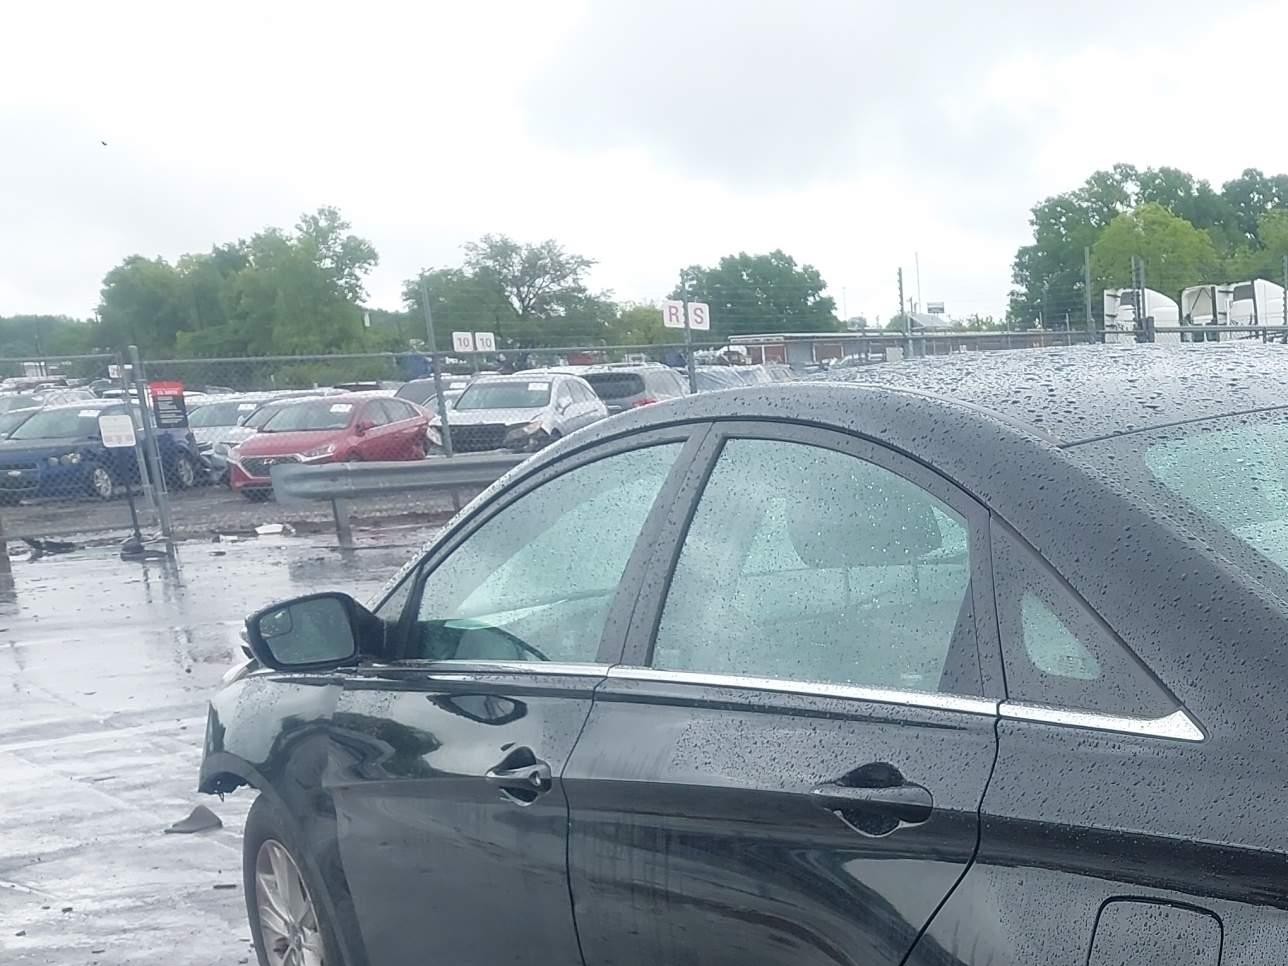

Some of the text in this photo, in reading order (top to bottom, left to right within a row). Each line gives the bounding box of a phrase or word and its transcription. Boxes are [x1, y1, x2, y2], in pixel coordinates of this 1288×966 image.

[669, 305, 680, 323] R
[693, 307, 704, 325] S
[457, 337, 470, 348] 10
[479, 337, 492, 348] 10
